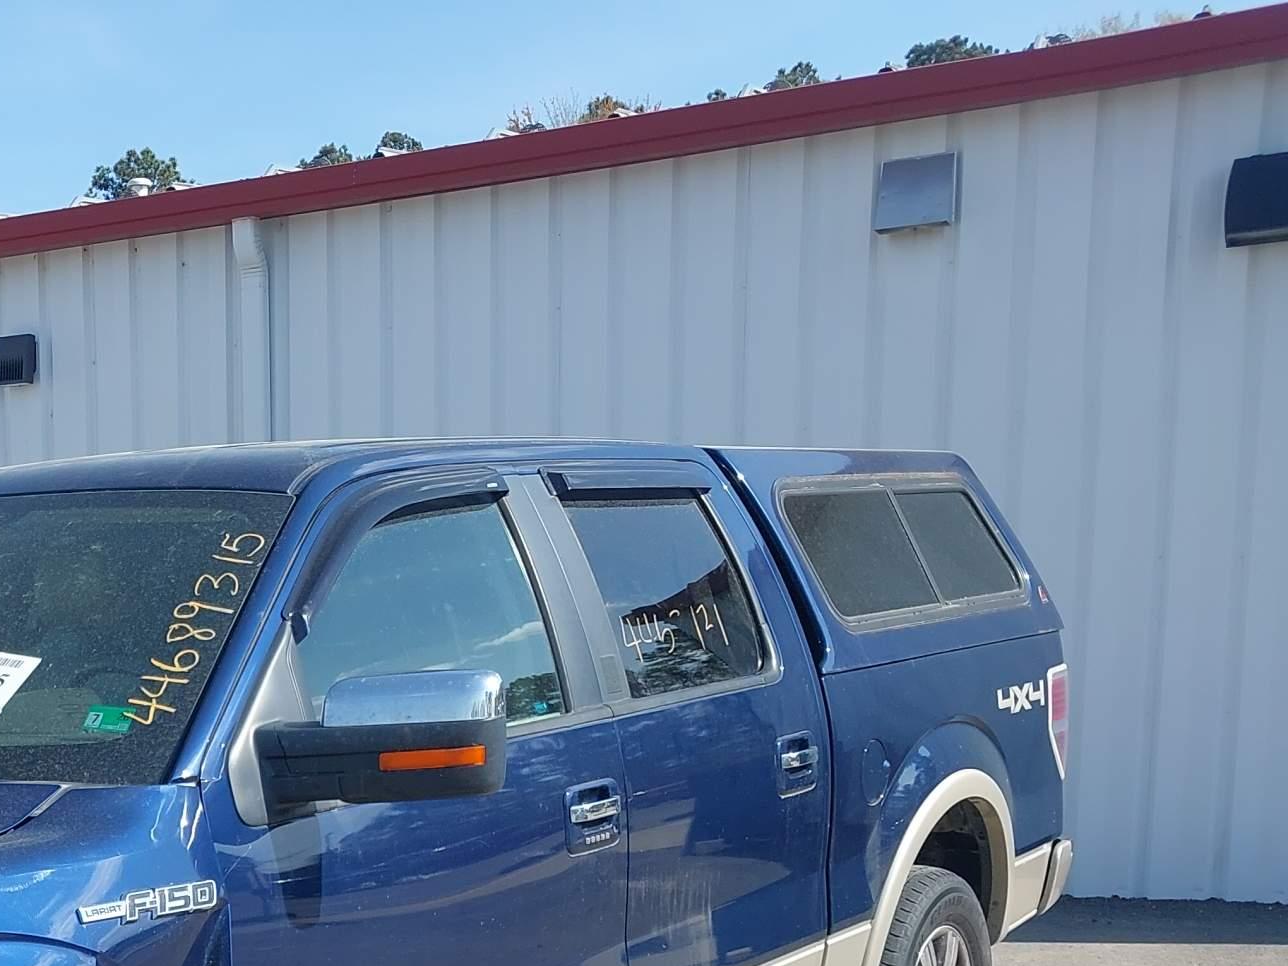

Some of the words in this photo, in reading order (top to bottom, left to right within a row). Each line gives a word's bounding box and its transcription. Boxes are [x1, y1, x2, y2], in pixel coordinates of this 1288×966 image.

[123, 533, 265, 725] 44689315
[85, 903, 123, 918] LARIAT
[125, 880, 217, 922] F-150
